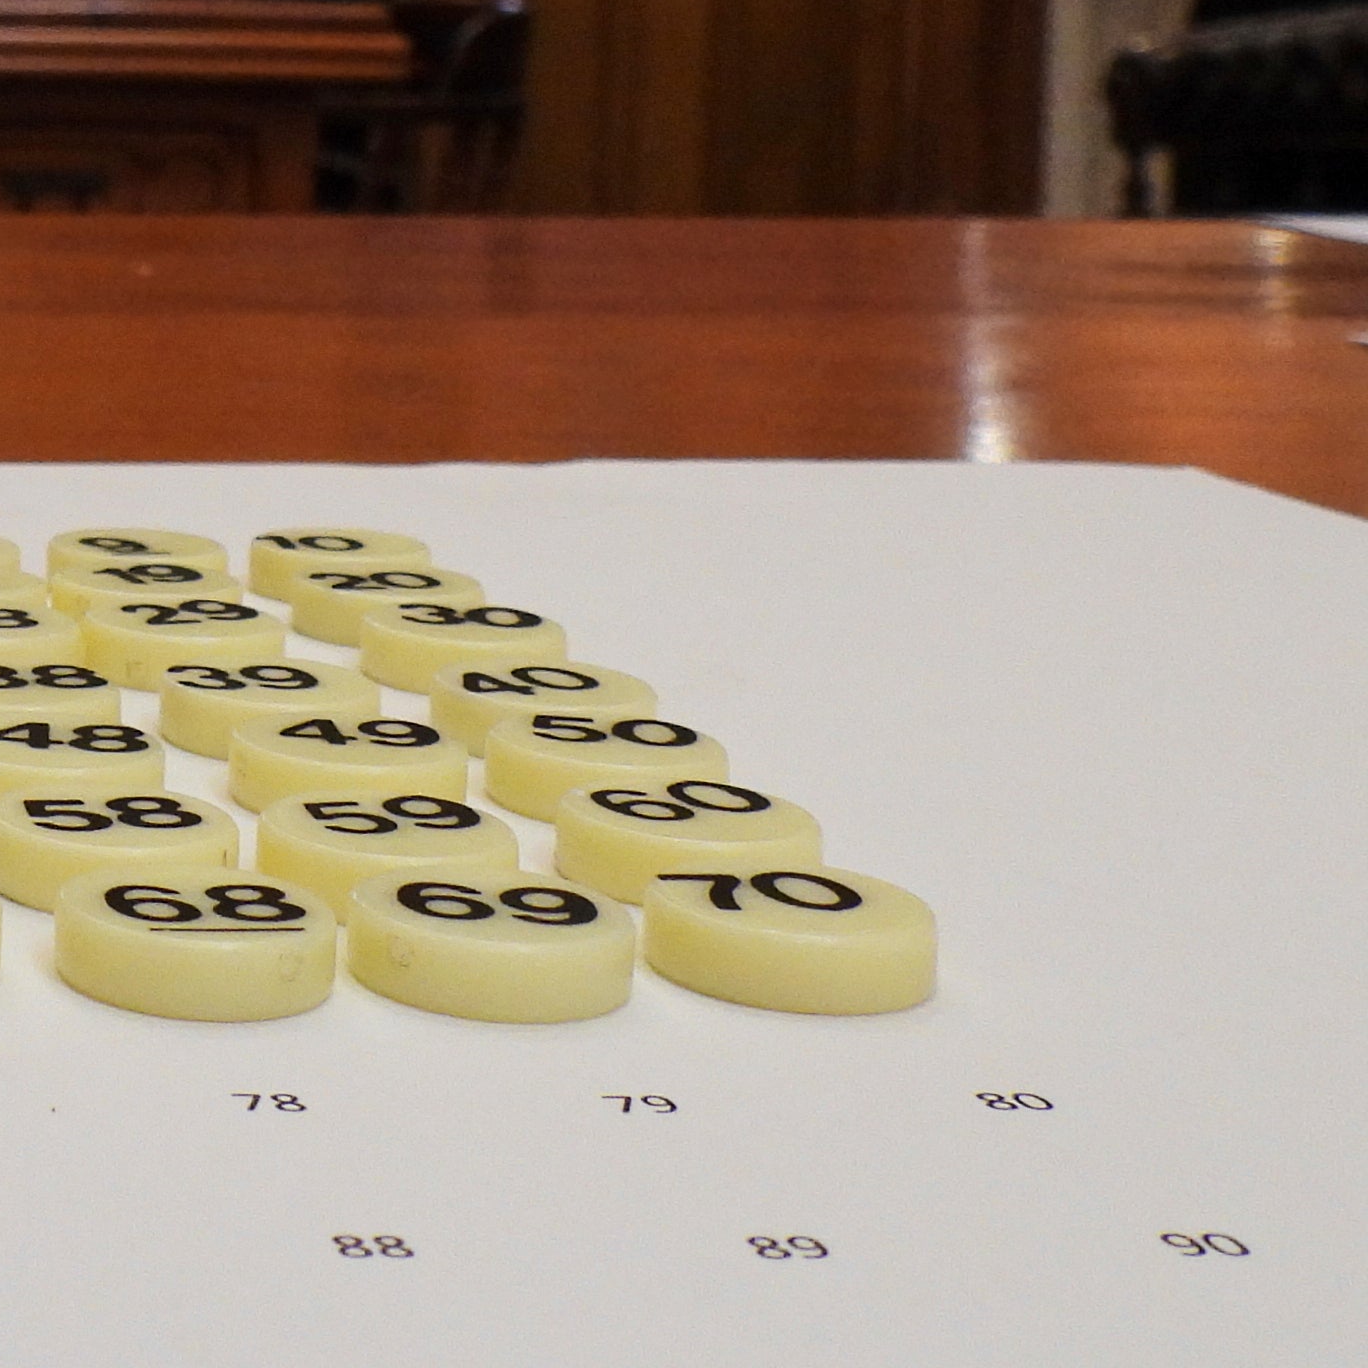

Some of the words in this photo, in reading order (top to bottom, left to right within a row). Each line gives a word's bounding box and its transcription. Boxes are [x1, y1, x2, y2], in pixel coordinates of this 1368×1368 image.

[78, 537, 154, 555] 9
[255, 535, 365, 552] 10
[93, 563, 204, 585] 19
[308, 571, 442, 591] 20
[120, 599, 260, 626] 29
[398, 603, 543, 629] 30
[167, 665, 319, 691] 39
[462, 666, 600, 696] 40
[278, 718, 441, 748] 49
[531, 714, 698, 747] 50
[23, 796, 203, 833] 58
[303, 794, 482, 835] 59
[589, 780, 772, 822] 60
[396, 881, 599, 927] 69
[656, 871, 863, 912] 70
[103, 884, 307, 933] 68
[230, 1093, 307, 1113] 78
[602, 1095, 678, 1114] 79
[975, 1092, 1054, 1111] 80
[332, 1235, 415, 1259] 88
[747, 1236, 829, 1260] 89
[1160, 1233, 1251, 1257] 90
